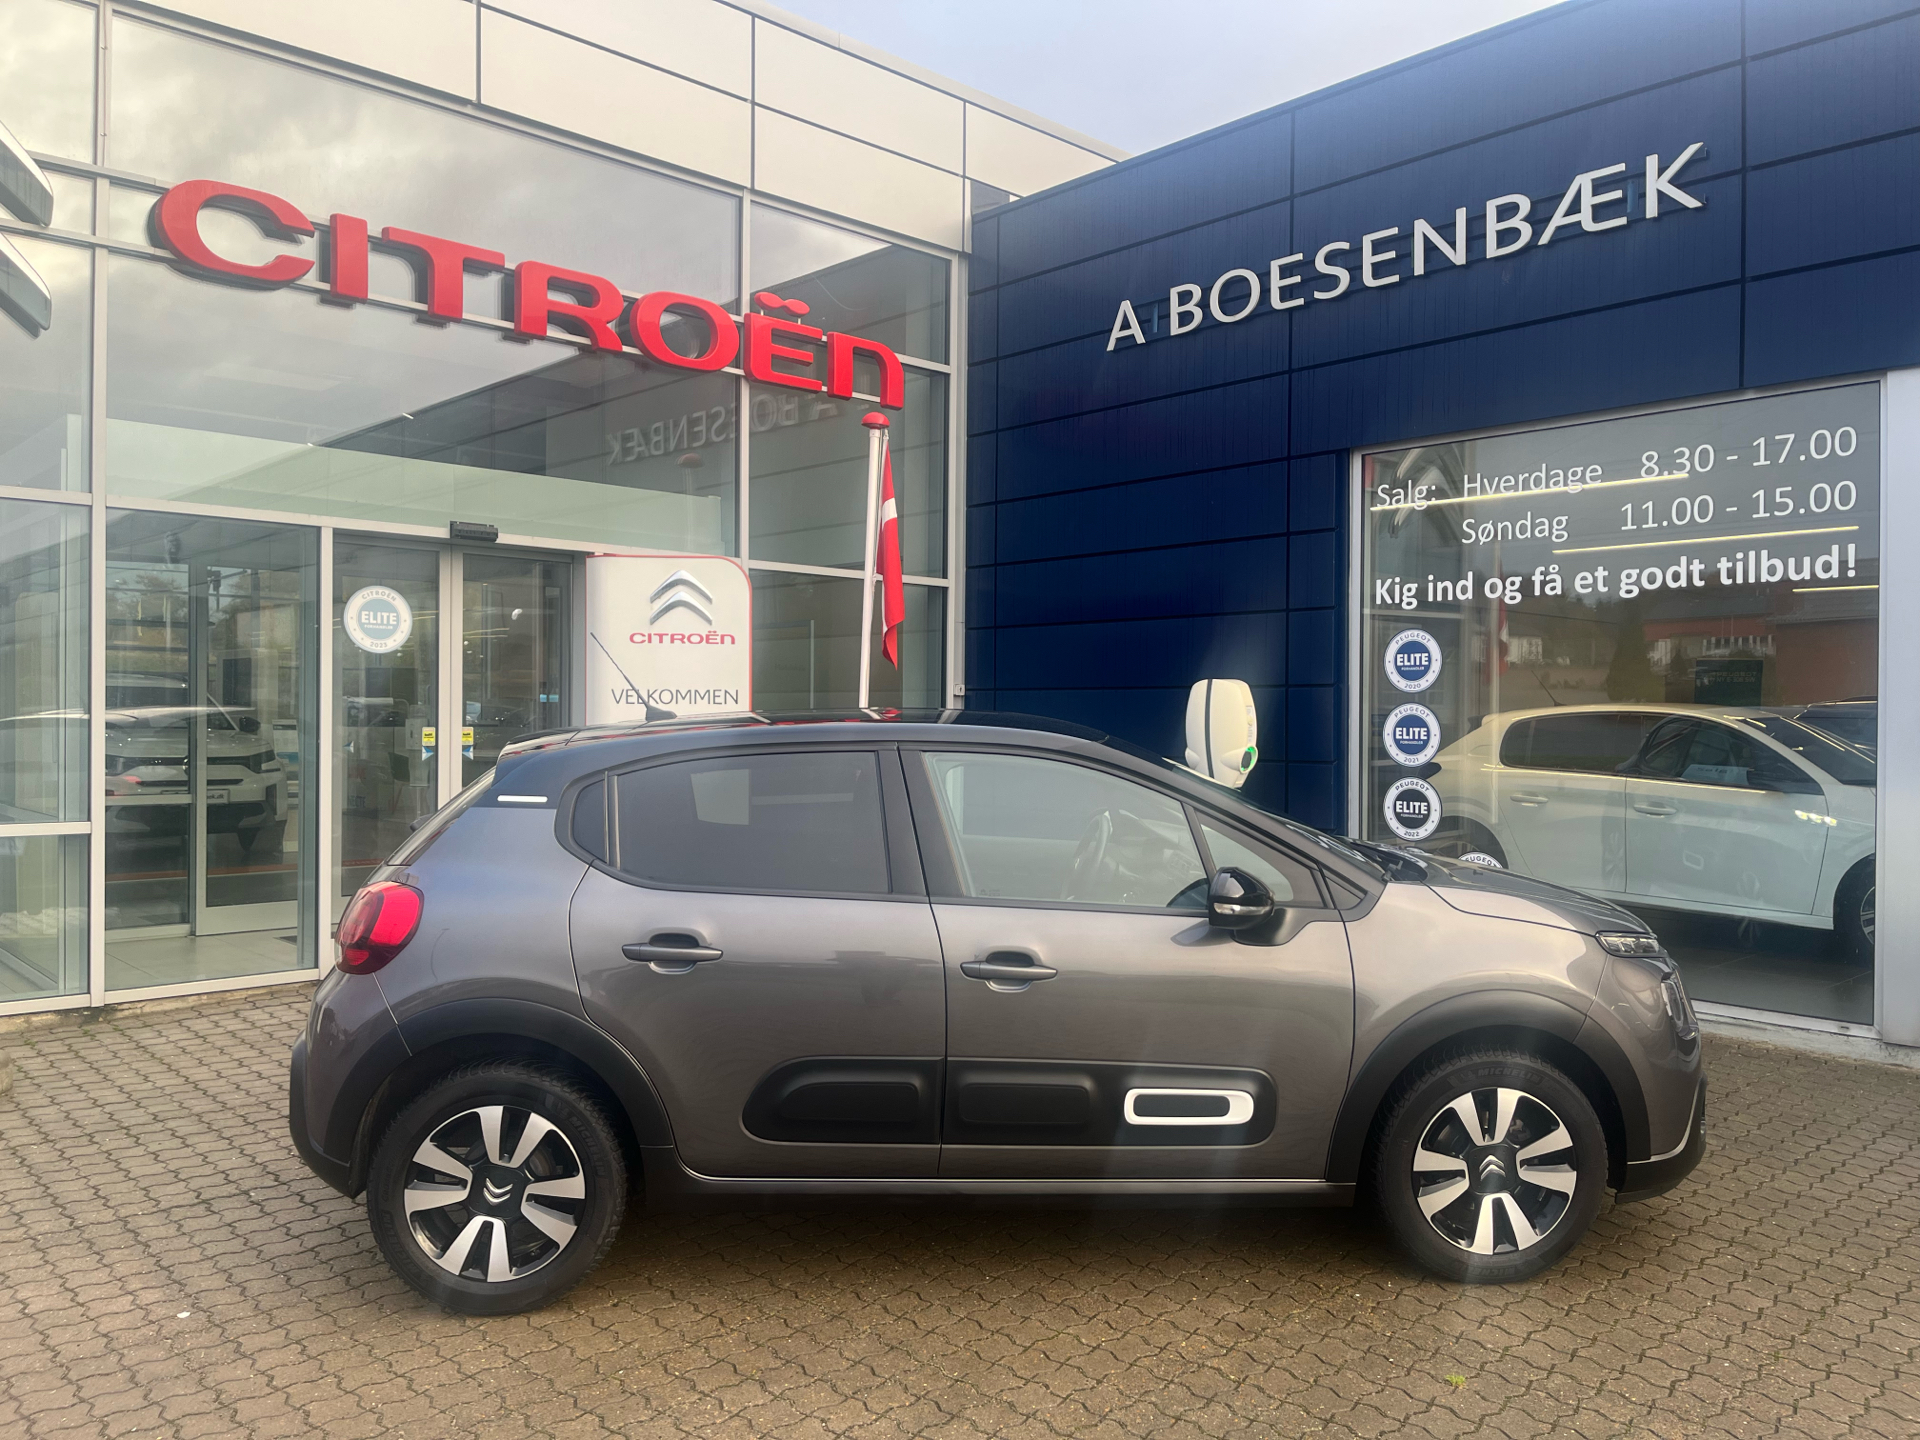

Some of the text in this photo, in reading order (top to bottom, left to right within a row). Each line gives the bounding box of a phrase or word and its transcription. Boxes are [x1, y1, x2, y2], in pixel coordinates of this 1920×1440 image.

[1105, 141, 1705, 352] A BOESENBÆK
[153, 178, 906, 411] CITROËN
[1376, 479, 1437, 511] Salg:
[1463, 462, 1603, 498] Hverdage
[1640, 444, 1716, 479] 8.30
[1752, 426, 1857, 467] 17.00
[1461, 511, 1569, 546] Søndag
[1620, 494, 1715, 531] 11.00
[1752, 480, 1857, 519] 15.00
[1374, 543, 1856, 610] Kig ind og få et godt tilbud!
[361, 610, 397, 625] ELITE
[369, 641, 388, 649] 2023
[1395, 632, 1431, 645] PEUGEOT
[1396, 653, 1429, 666] ELITE
[611, 688, 739, 705] VELKOMMEN
[1394, 706, 1430, 718] PEUGEOT
[1395, 727, 1428, 740] ELITE
[1394, 781, 1430, 792] PEUGEOT
[1395, 800, 1428, 814] ELITE
